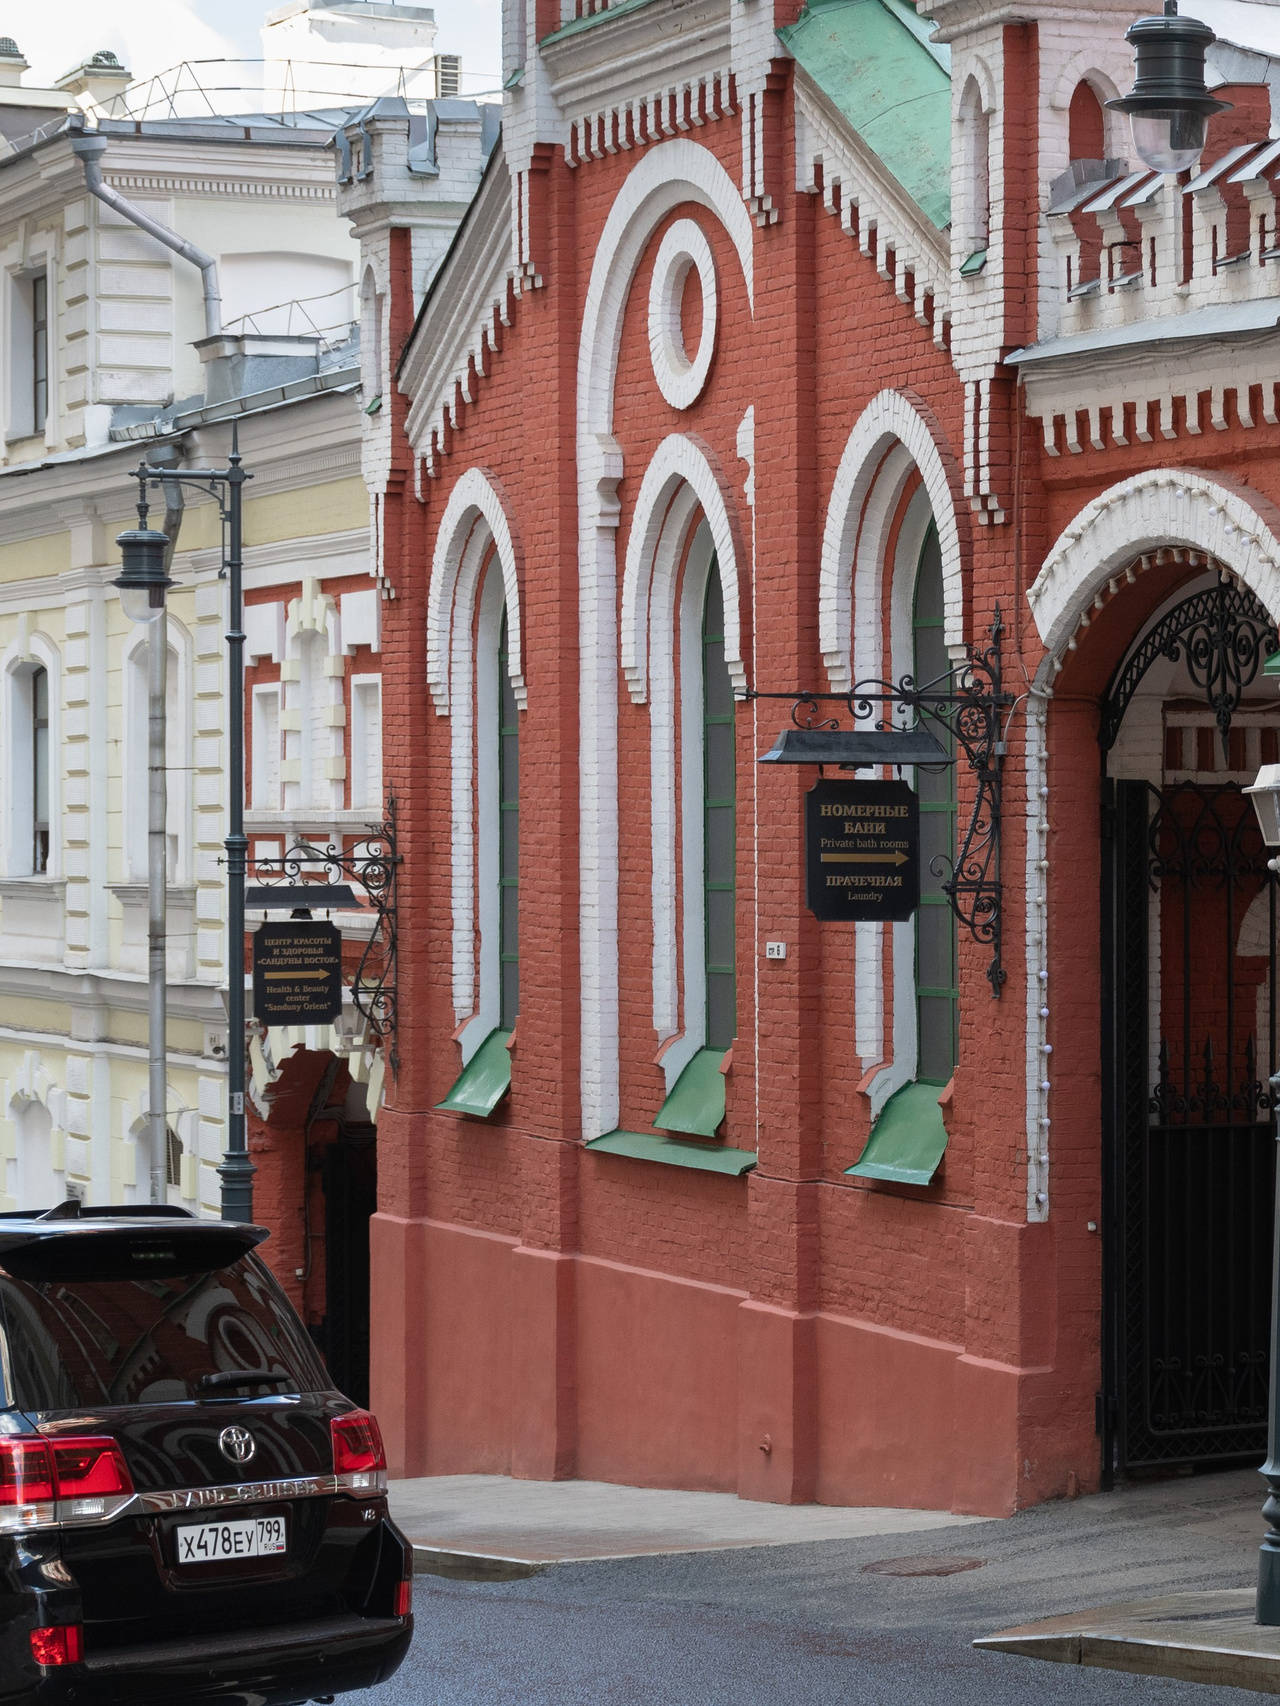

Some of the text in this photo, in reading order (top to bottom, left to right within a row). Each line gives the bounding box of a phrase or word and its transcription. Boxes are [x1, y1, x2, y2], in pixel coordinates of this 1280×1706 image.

[820, 804, 909, 818] НОМЕРНЫЕ
[844, 822, 886, 834] БАНИ
[820, 838, 909, 848] Private bath rooms
[826, 875, 902, 887] ПРАЧЕЧНАЯ
[848, 891, 883, 902] Laundry
[264, 937, 332, 946] ЦЕНТР КРАСОТЫ
[281, 947, 324, 956] ЗДОРОВЬЯ
[266, 985, 329, 993] Health & Beauty
[171, 1488, 227, 1507] LAND
[257, 1519, 281, 1543] 799
[263, 1542, 276, 1551] RUS
